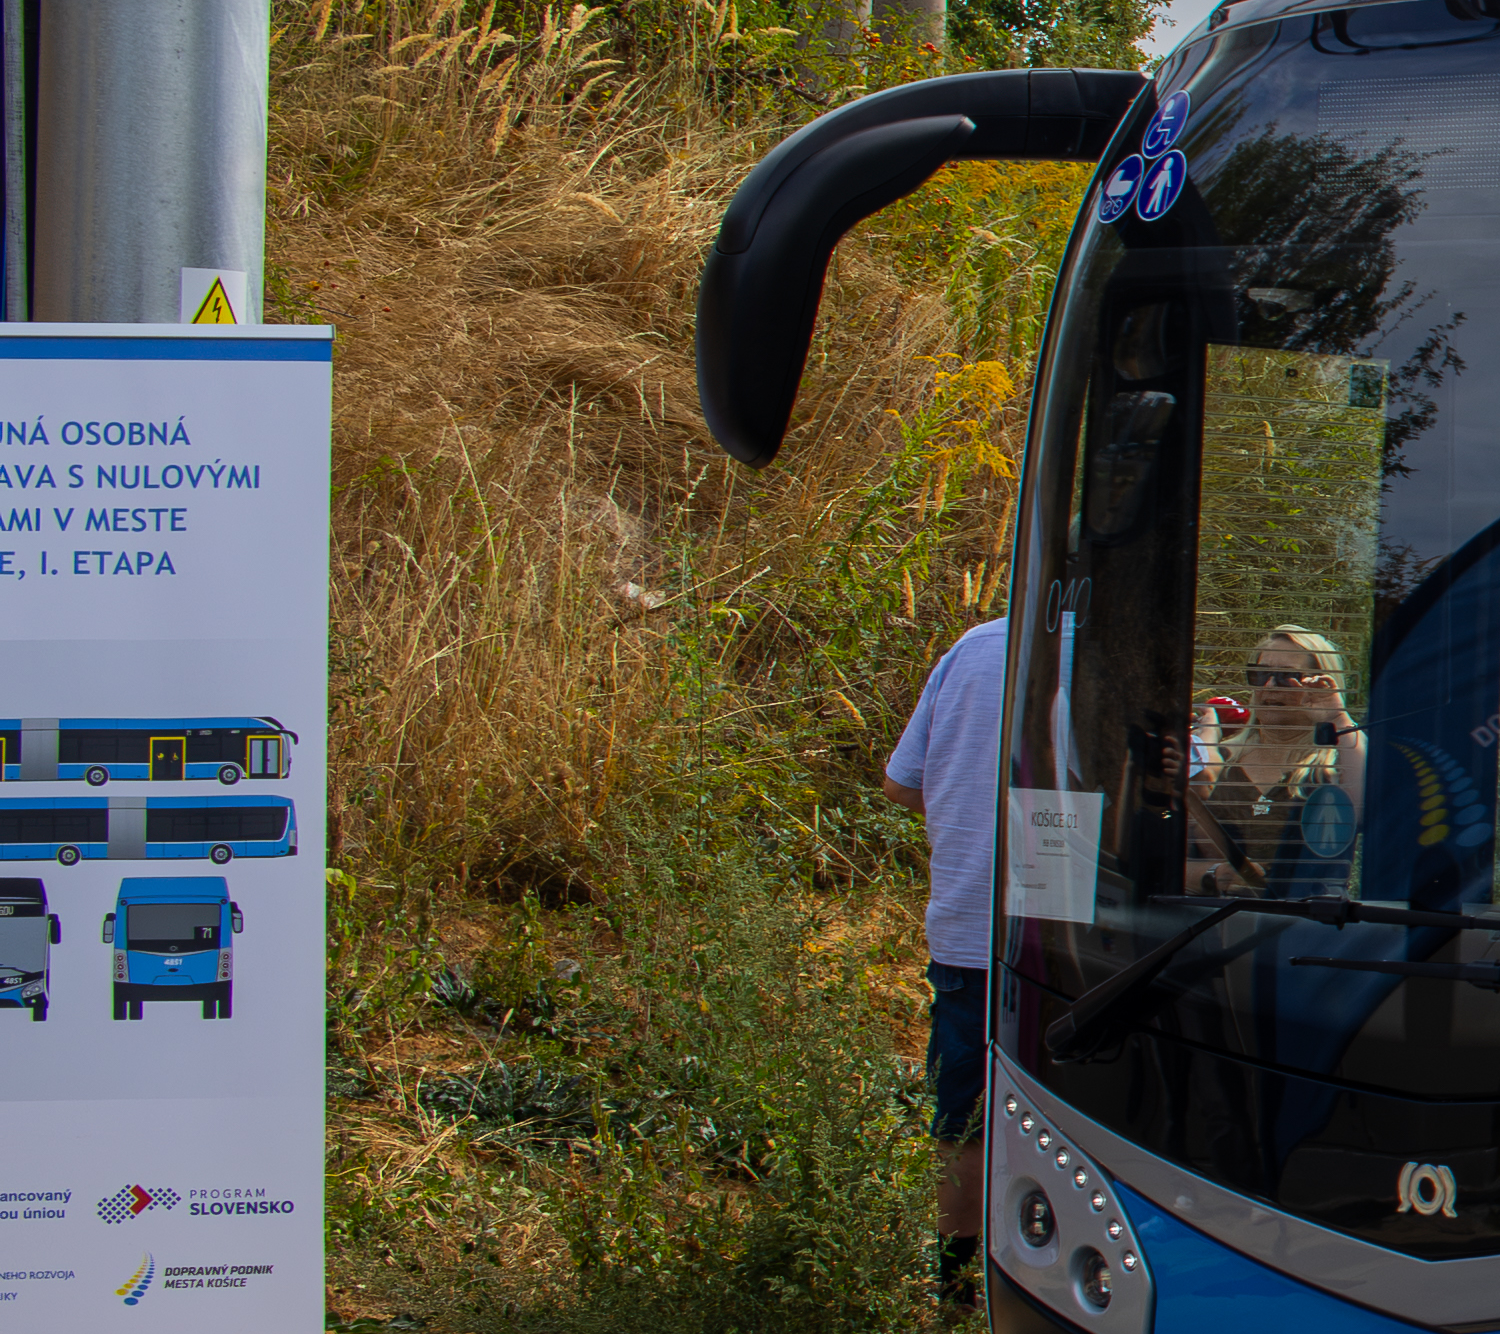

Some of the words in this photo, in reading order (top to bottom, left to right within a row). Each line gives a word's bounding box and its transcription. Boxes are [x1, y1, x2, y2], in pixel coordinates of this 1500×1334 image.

[60, 415, 191, 446] OSOBNÁ
[68, 464, 84, 489] S
[97, 458, 260, 489] NULOVÝMI
[53, 507, 75, 532] V
[85, 507, 188, 532] MESTE
[40, 551, 59, 576] I.
[73, 551, 177, 576] ETAPA
[1031, 808, 1064, 827] KOŠICE
[1066, 813, 1078, 828] 01
[202, 927, 213, 939] 71
[189, 1188, 266, 1199] PROGRAM
[23, 1207, 66, 1220] úniou
[189, 1200, 295, 1216] SLOVENSKO
[29, 1270, 75, 1280] ROZVOJA
[164, 1264, 229, 1276] DOPRAVNÝ
[229, 1264, 274, 1275] PODNIK
[164, 1278, 204, 1289] MESTA
[206, 1276, 248, 1288] KOŠICE
